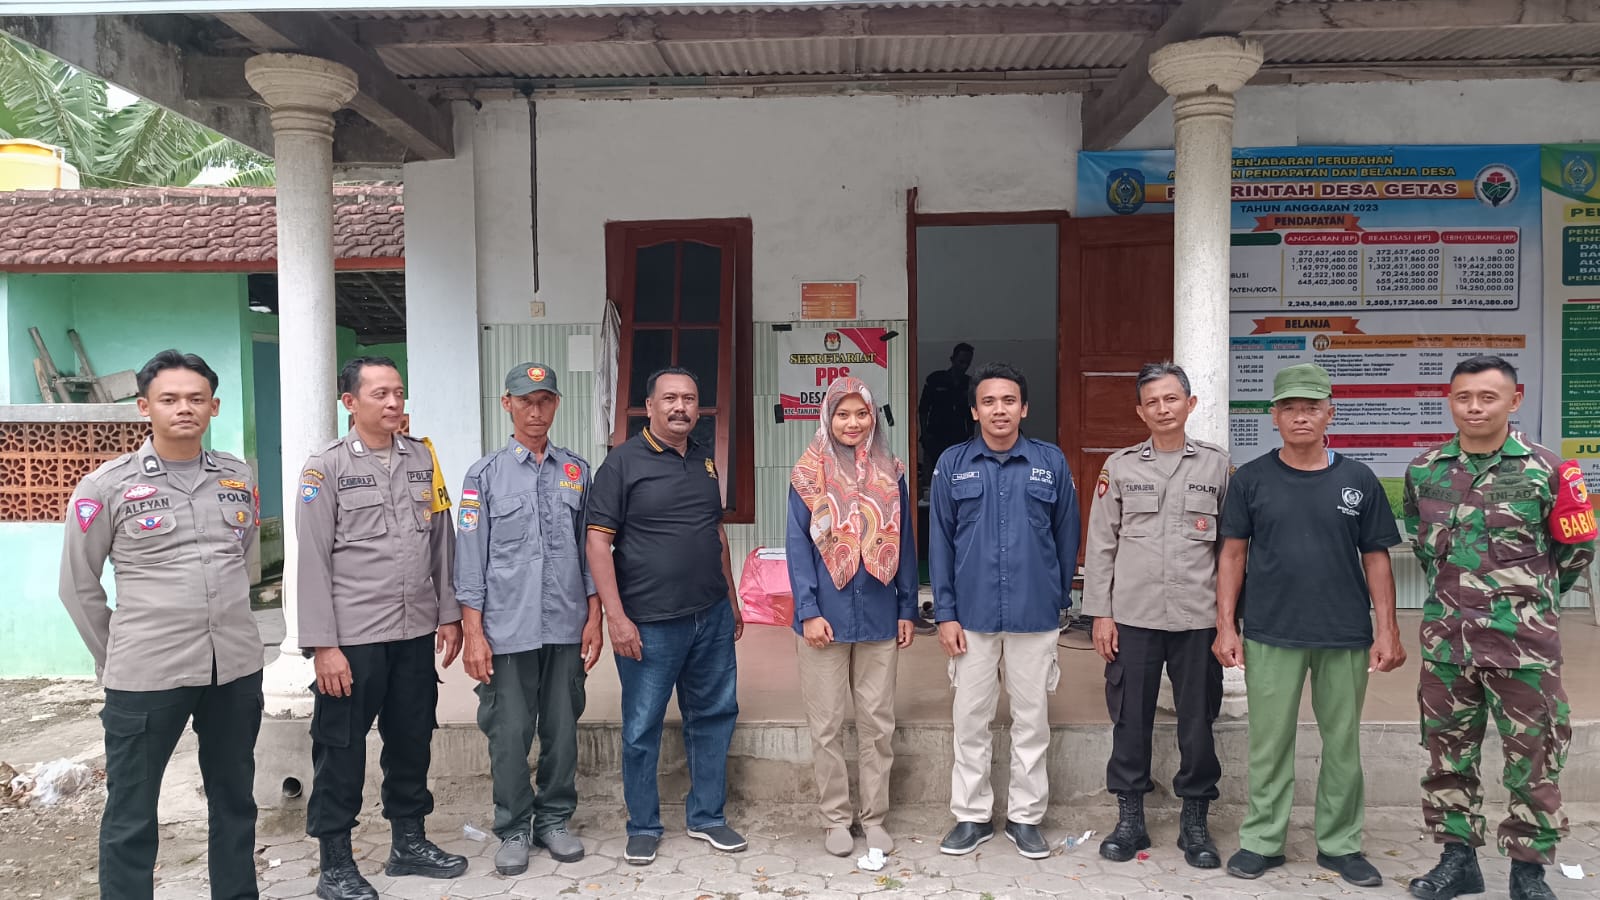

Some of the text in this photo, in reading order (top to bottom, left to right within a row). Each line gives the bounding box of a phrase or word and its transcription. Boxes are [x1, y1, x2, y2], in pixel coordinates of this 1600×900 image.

[1318, 155, 1393, 166] PERUBAHAN
[1245, 168, 1328, 178] PENDAPATAN
[1332, 168, 1358, 177] DAN
[1361, 167, 1418, 177] BELANJA
[1421, 167, 1456, 176] DESA
[1321, 184, 1378, 196] DESA
[1384, 182, 1458, 196] GETAS
[1240, 203, 1379, 213] TAHUN ANGGARAN 2023
[1274, 216, 1345, 226] PENDAPATAN
[1342, 235, 1358, 243] (RP)
[1368, 234, 1431, 242] REALISASI (RP)
[1298, 249, 1358, 257] 372,637,400.00
[1376, 248, 1440, 256] 372,637,400.00
[1376, 277, 1439, 285] 655,402,300.00
[1284, 319, 1331, 329] BELANJA
[790, 352, 877, 364] SEKRETARIAT
[815, 366, 851, 387] PPS
[801, 391, 827, 404] DESA
[1031, 467, 1052, 479] PPS
[1188, 483, 1217, 494] POLRI
[1487, 490, 1531, 501] TNI-AD
[125, 497, 170, 516] ALFYAN
